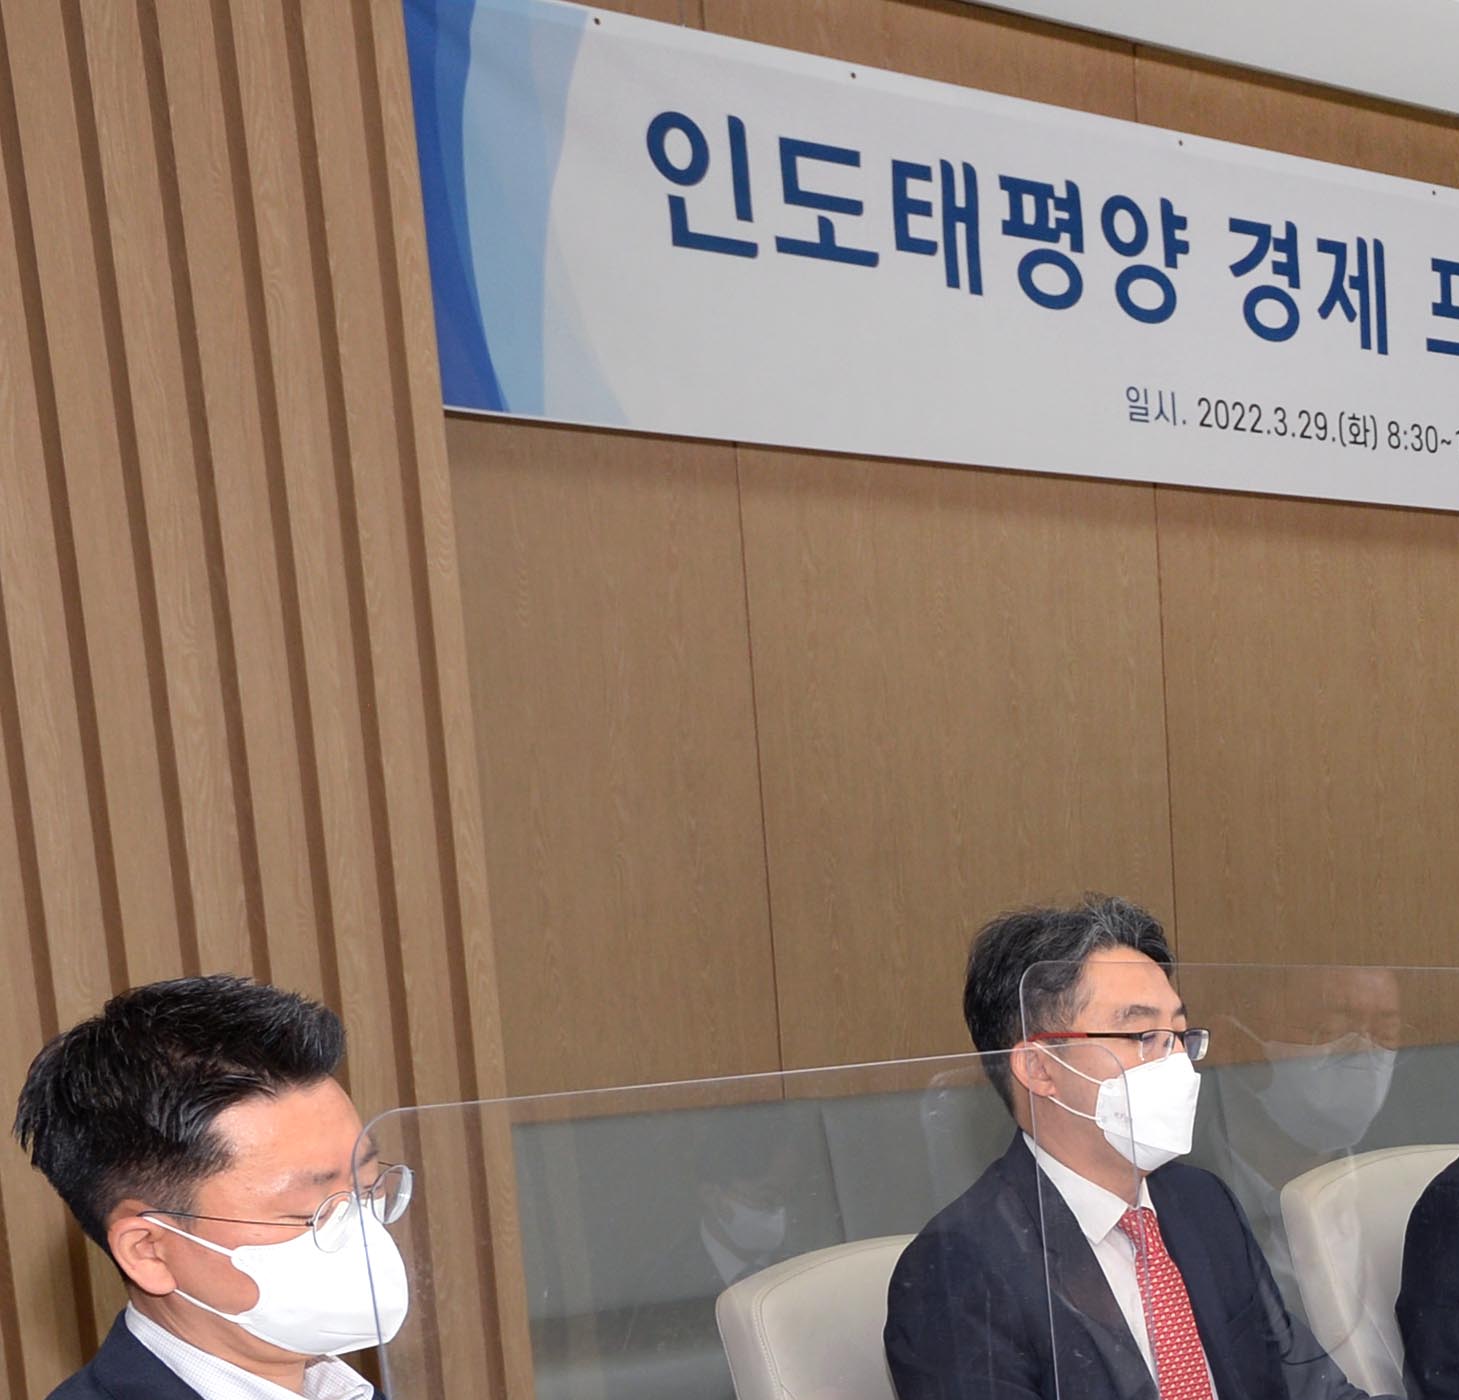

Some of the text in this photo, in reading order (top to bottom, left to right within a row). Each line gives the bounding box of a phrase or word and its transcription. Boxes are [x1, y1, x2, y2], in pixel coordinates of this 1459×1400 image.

[646, 110, 1189, 324] 인도태평양
[1228, 216, 1389, 357] 경제
[1126, 385, 1187, 426] 일시.
[1198, 397, 1378, 451] 2022.3.29.(화)
